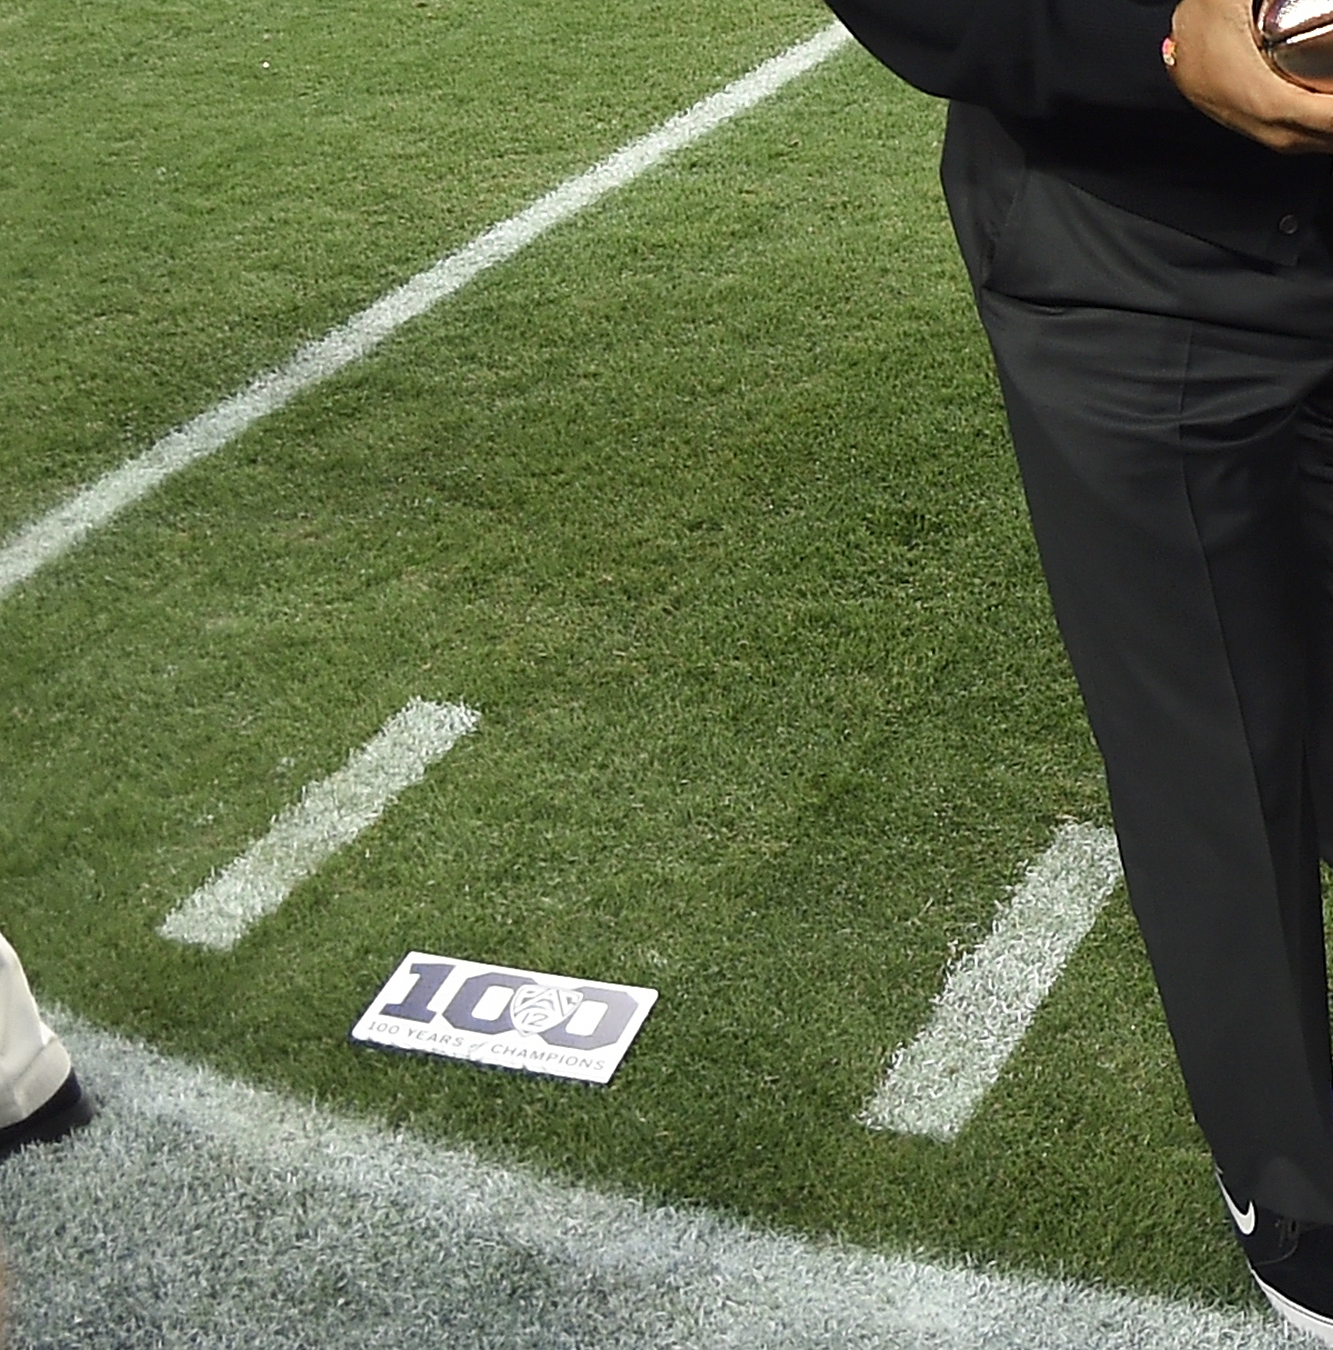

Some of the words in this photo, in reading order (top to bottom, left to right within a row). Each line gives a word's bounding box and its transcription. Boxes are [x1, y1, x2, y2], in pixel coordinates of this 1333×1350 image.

[379, 962, 639, 1051] 100
[367, 1020, 400, 1036] 100
[406, 1025, 464, 1048] YEARS
[490, 1043, 606, 1072] CHAMPIONS
